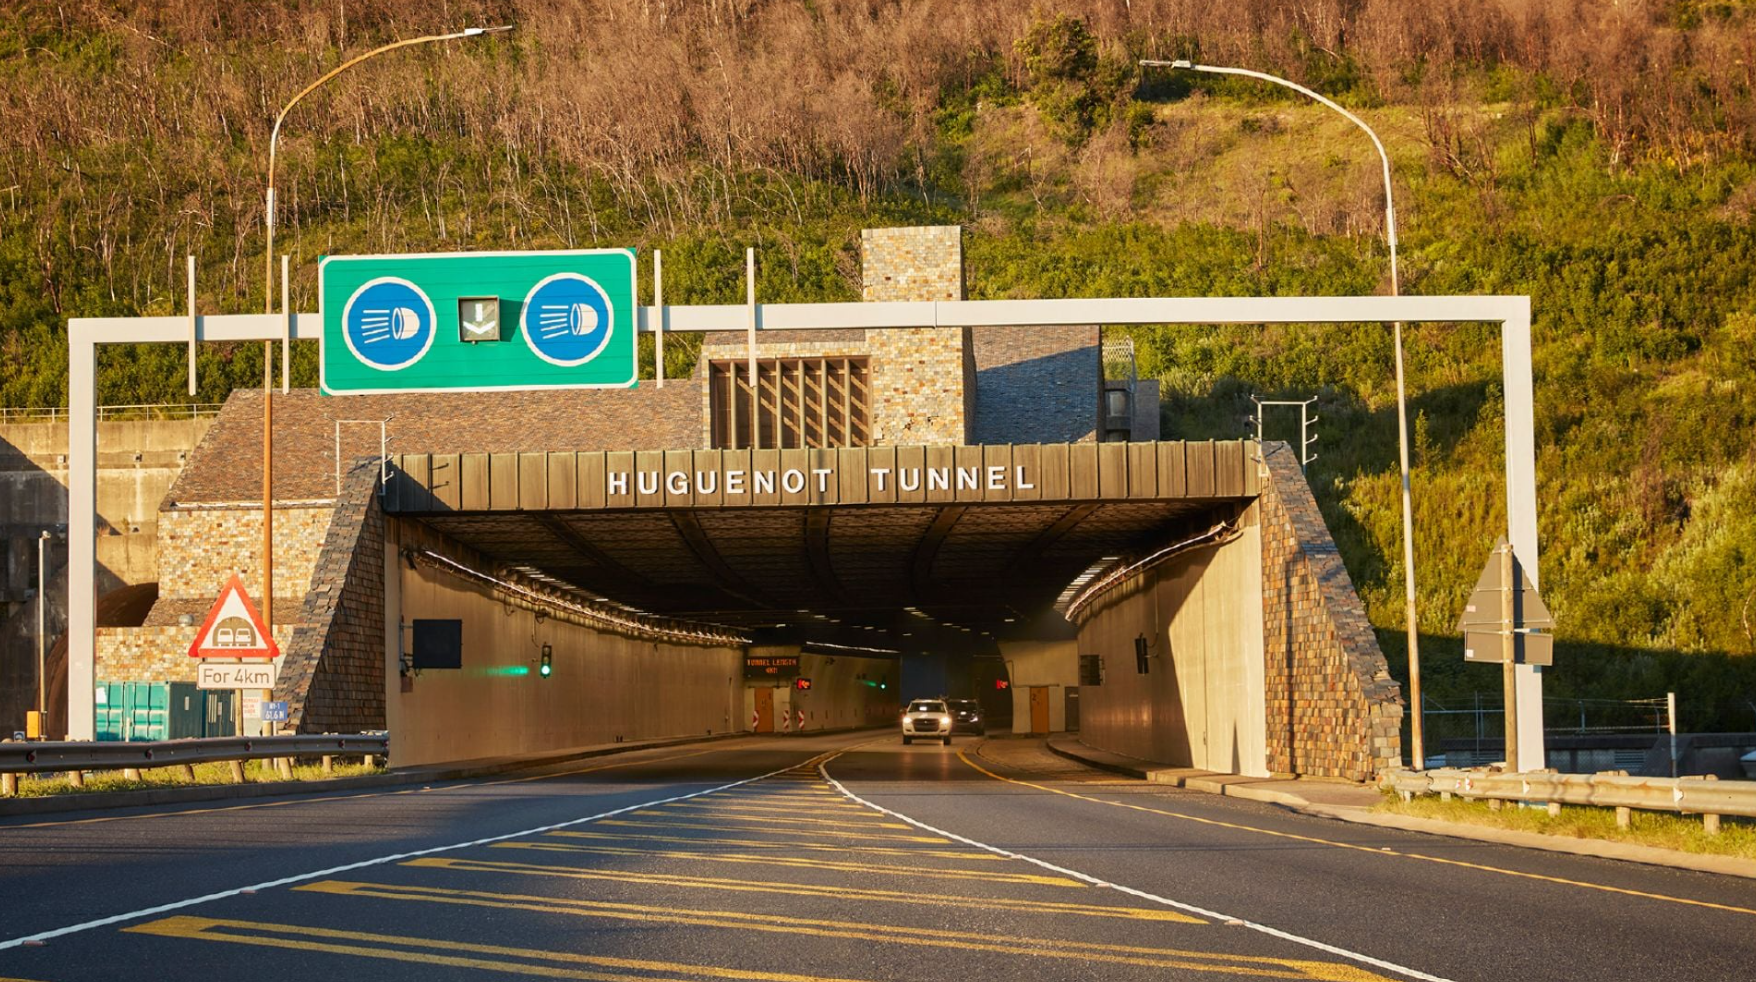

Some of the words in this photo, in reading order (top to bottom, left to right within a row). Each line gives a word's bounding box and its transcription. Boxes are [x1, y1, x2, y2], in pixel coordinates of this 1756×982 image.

[607, 468, 833, 496] HUGUENOT
[870, 465, 1035, 491] TUNNEL
[203, 668, 230, 684] For
[234, 668, 270, 684] 4km
